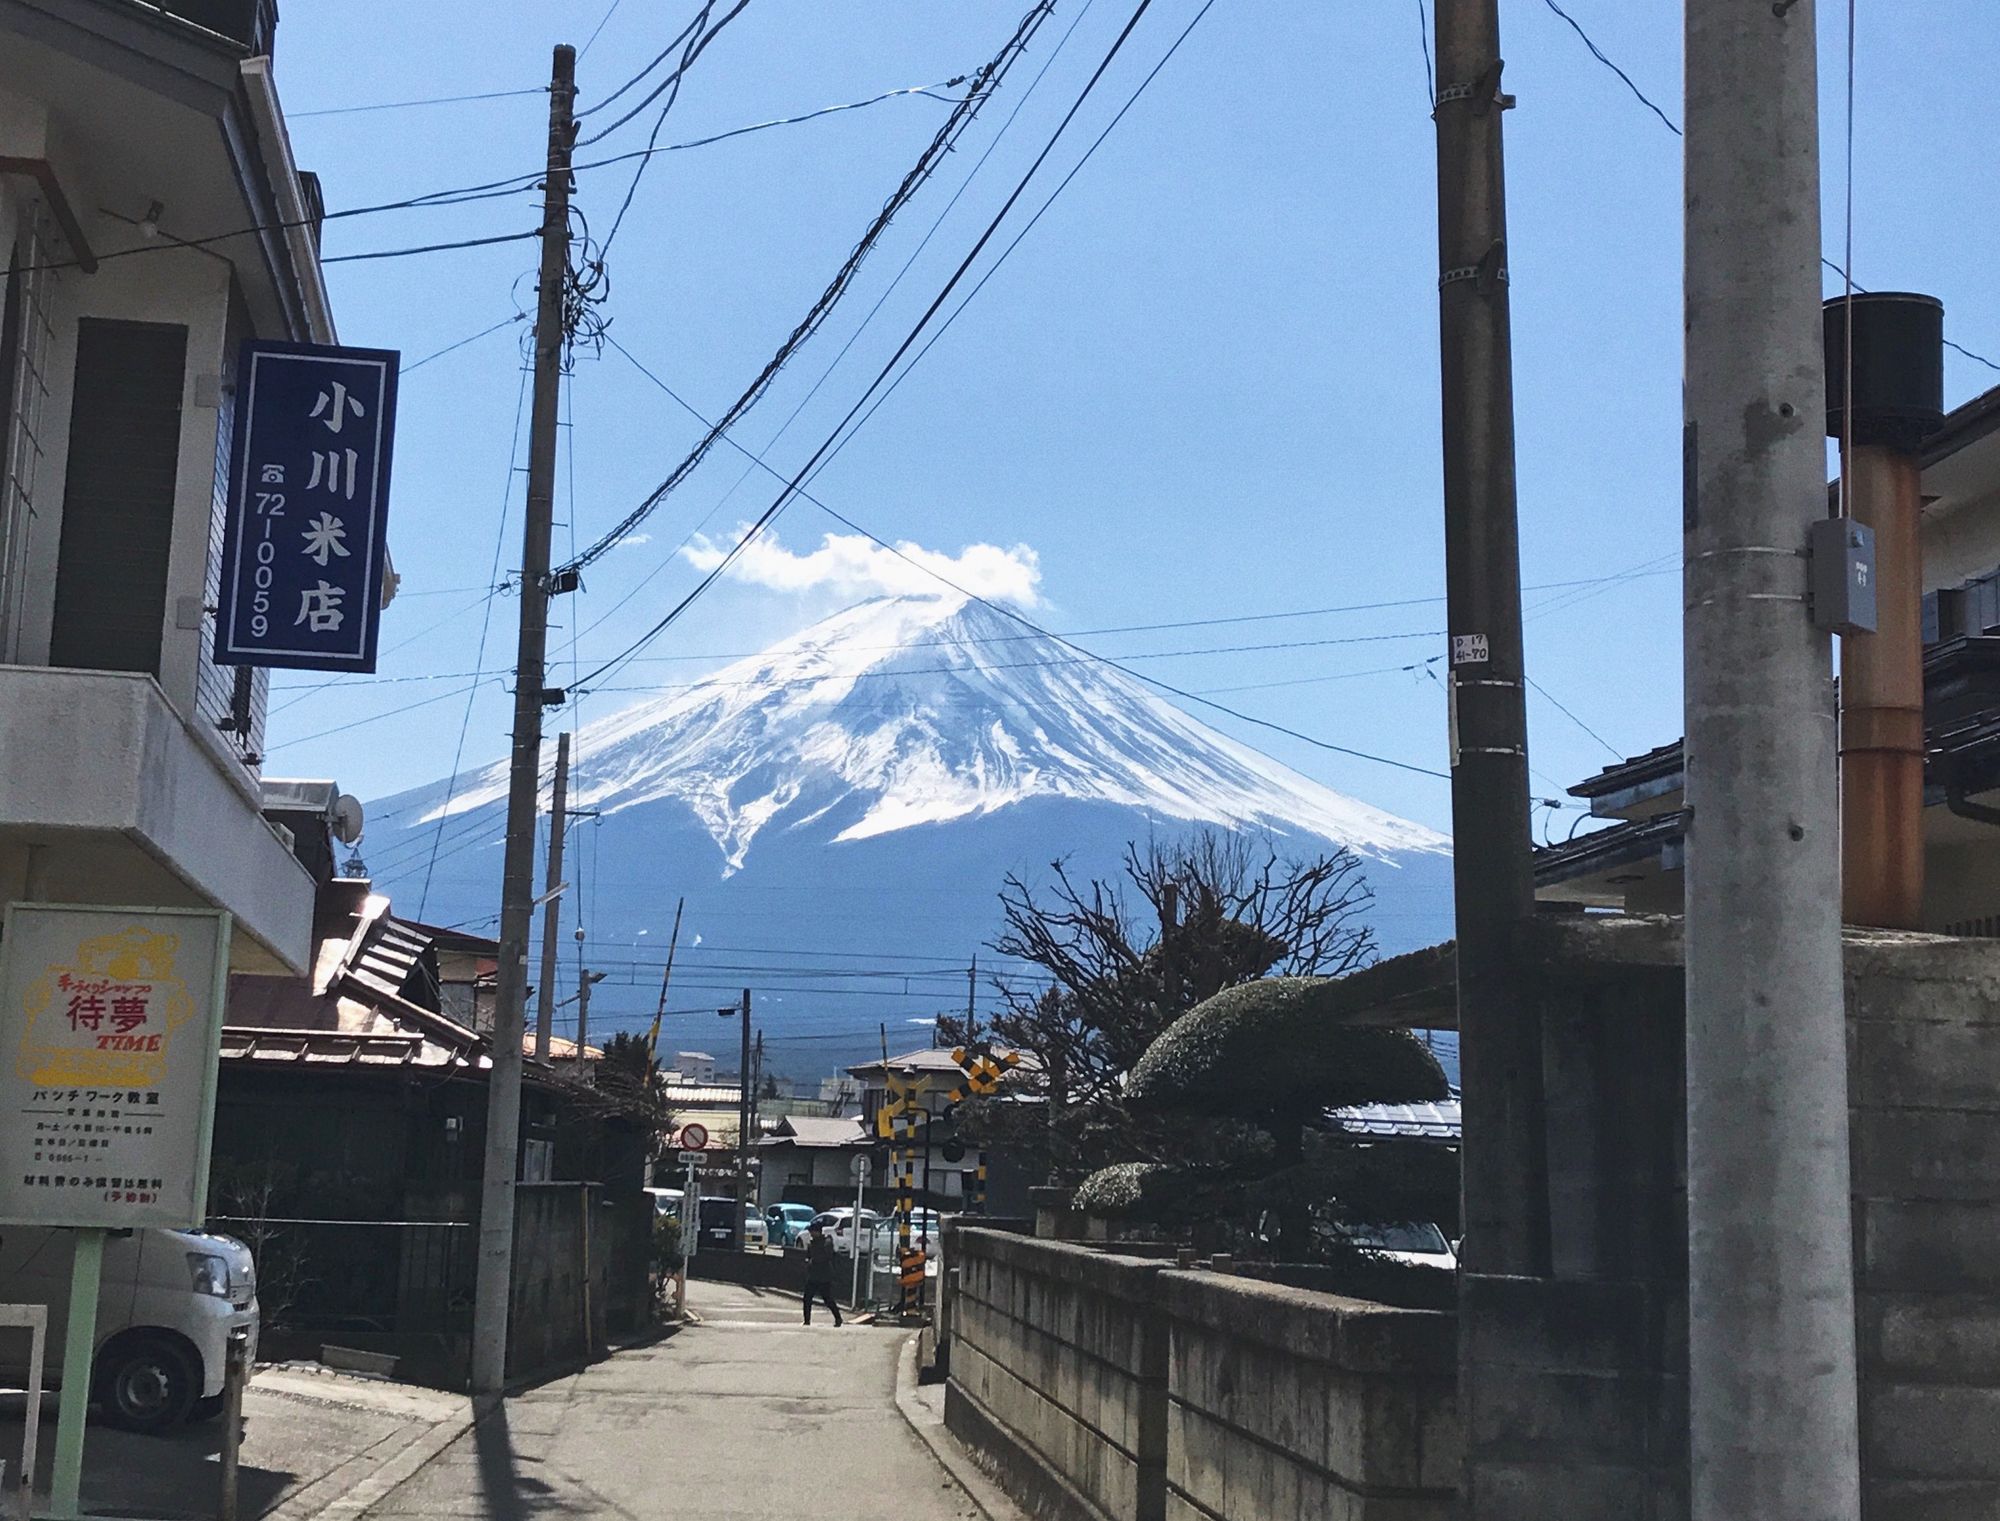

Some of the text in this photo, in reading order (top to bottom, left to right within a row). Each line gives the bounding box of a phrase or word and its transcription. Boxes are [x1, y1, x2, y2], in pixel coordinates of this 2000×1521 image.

[294, 381, 365, 632] 小川米店
[251, 493, 286, 638] 72-0059
[66, 995, 148, 1033] 待夢
[97, 1034, 162, 1052] TIME
